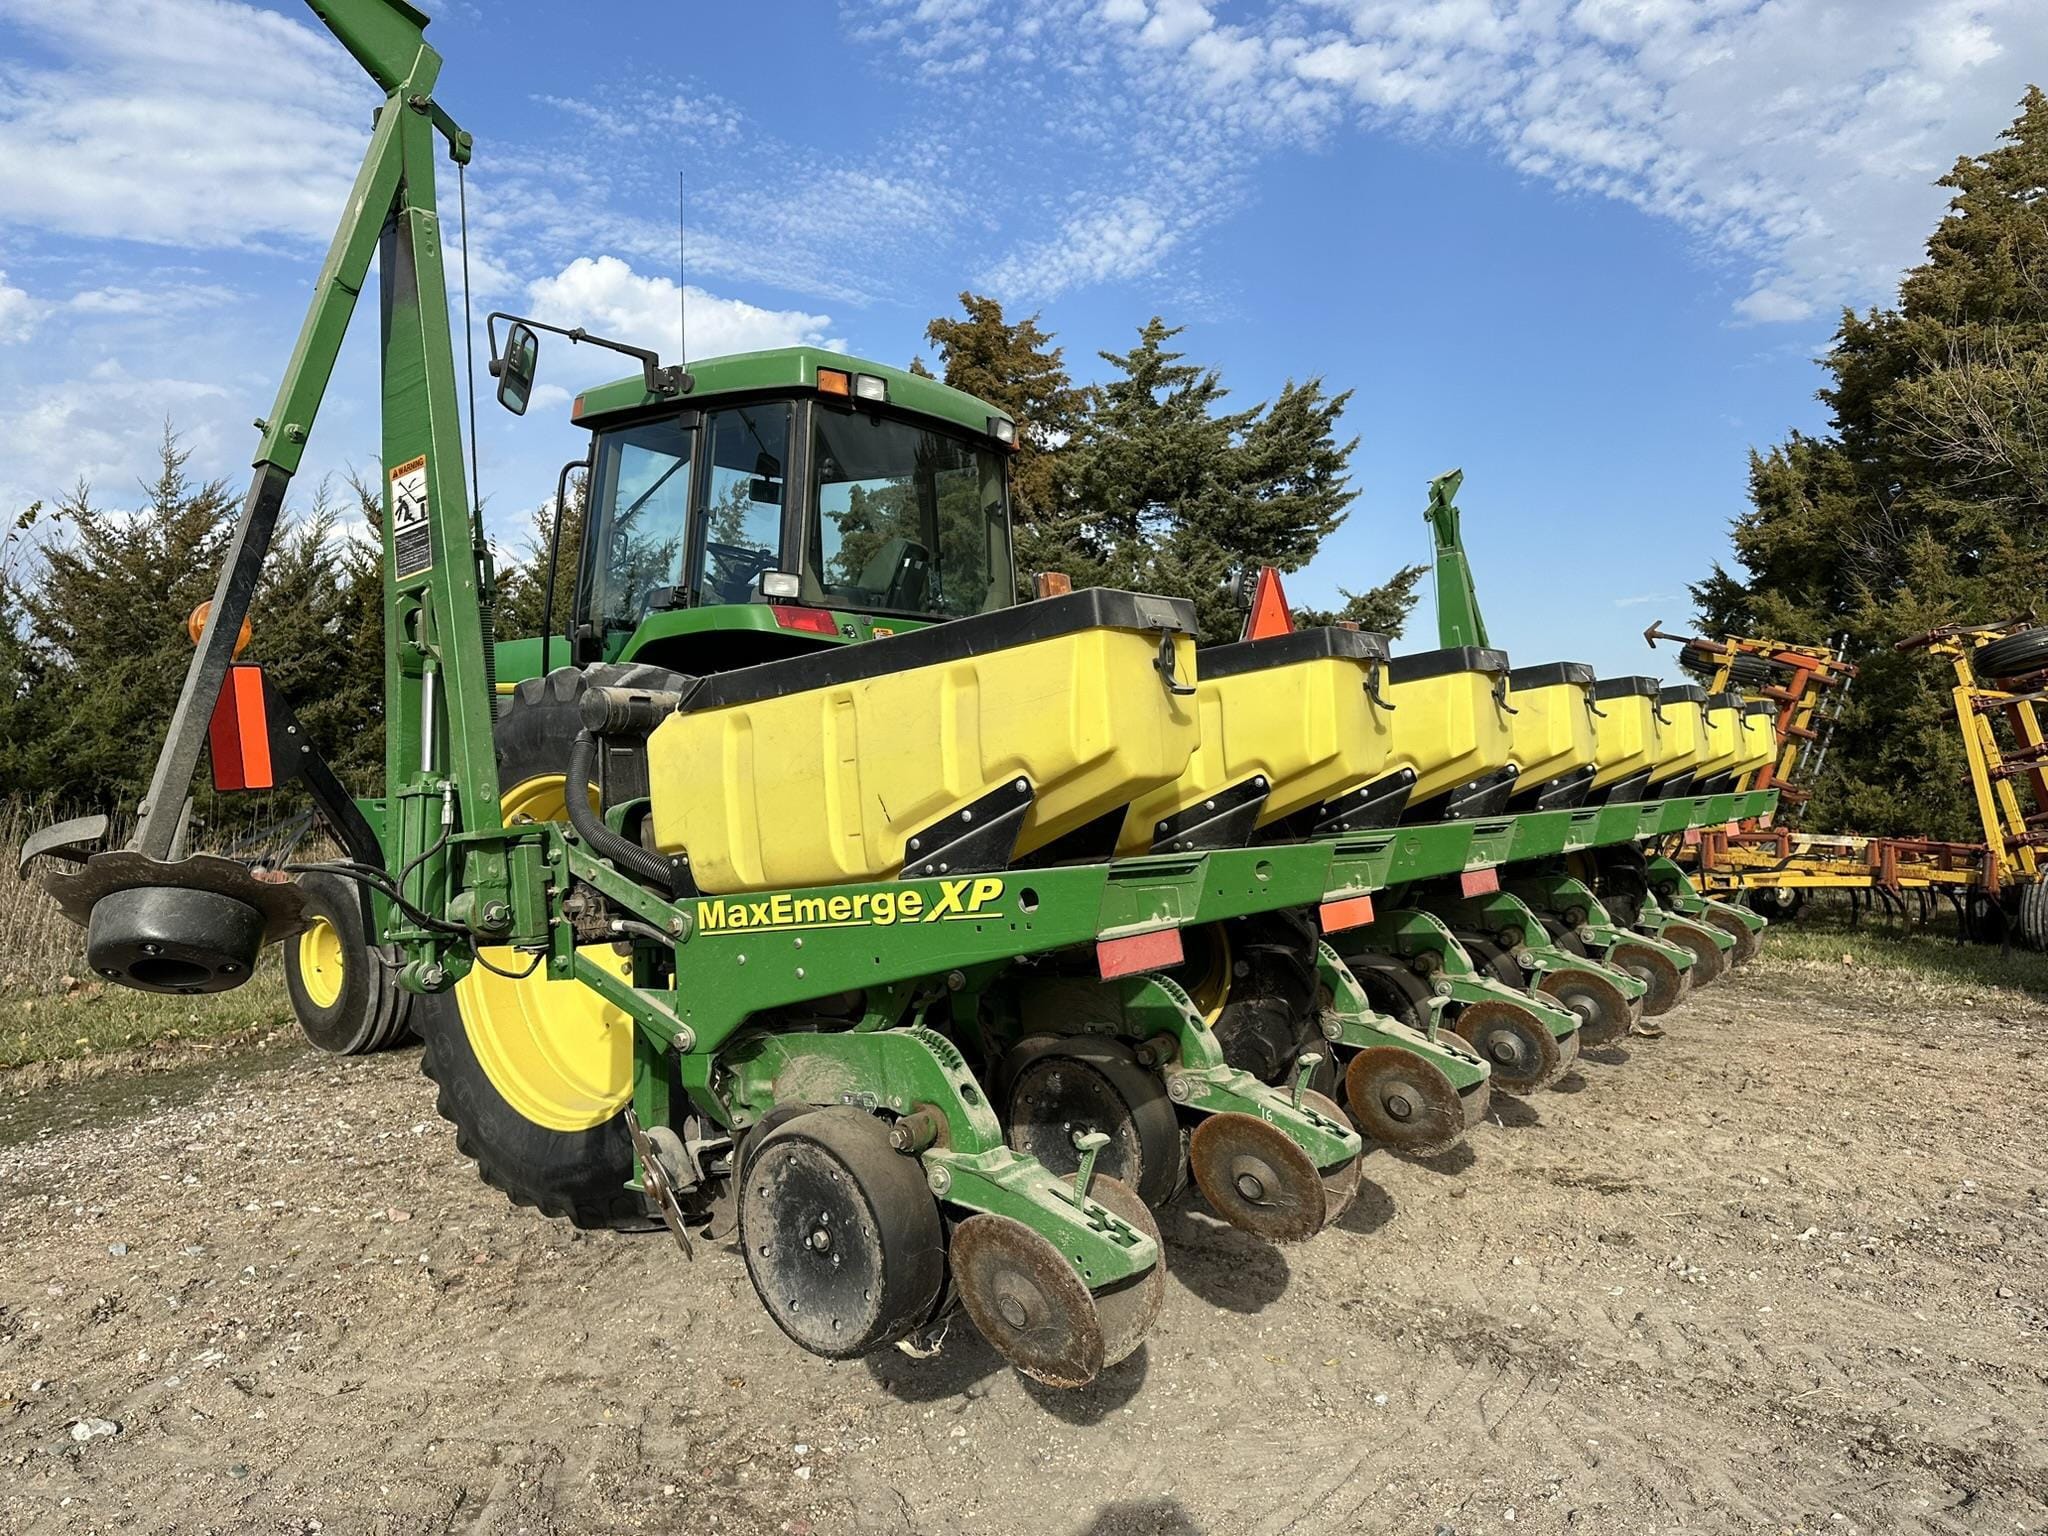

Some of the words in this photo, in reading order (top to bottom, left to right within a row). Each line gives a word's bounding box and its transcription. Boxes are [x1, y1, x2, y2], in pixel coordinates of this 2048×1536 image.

[398, 457, 424, 475] WARNING
[697, 890, 923, 930] MaxEmerge
[922, 878, 1004, 922] XP
